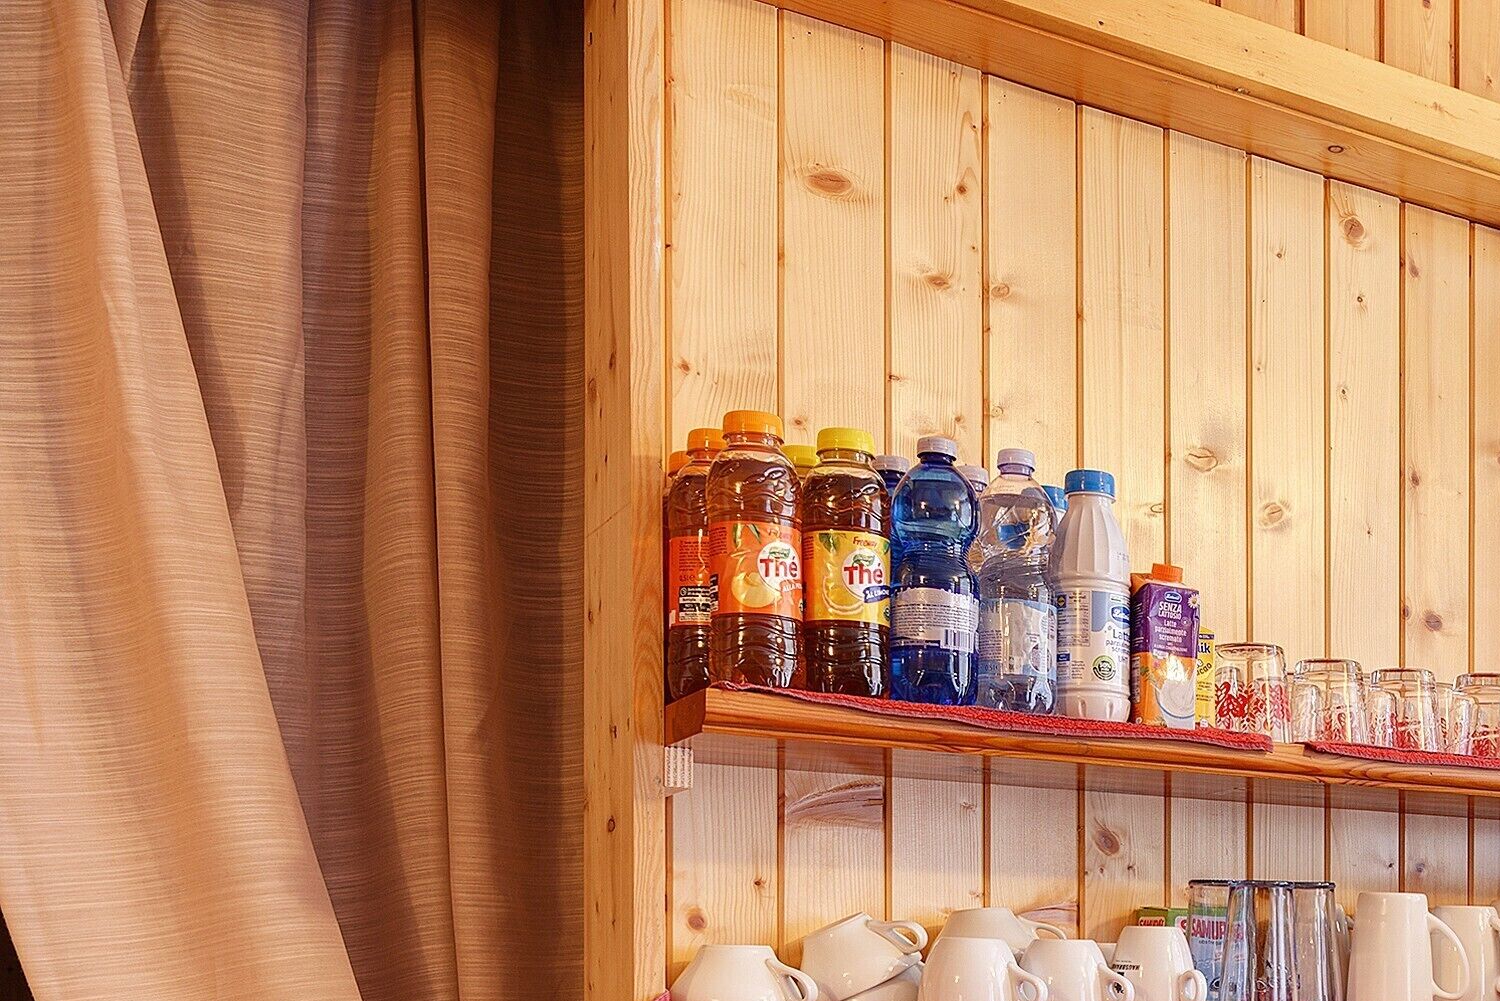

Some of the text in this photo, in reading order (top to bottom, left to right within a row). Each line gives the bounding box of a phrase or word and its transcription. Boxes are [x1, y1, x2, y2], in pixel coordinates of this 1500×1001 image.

[760, 555, 798, 577] Thé
[844, 562, 883, 585] Thé
[1159, 601, 1182, 613] SENZA
